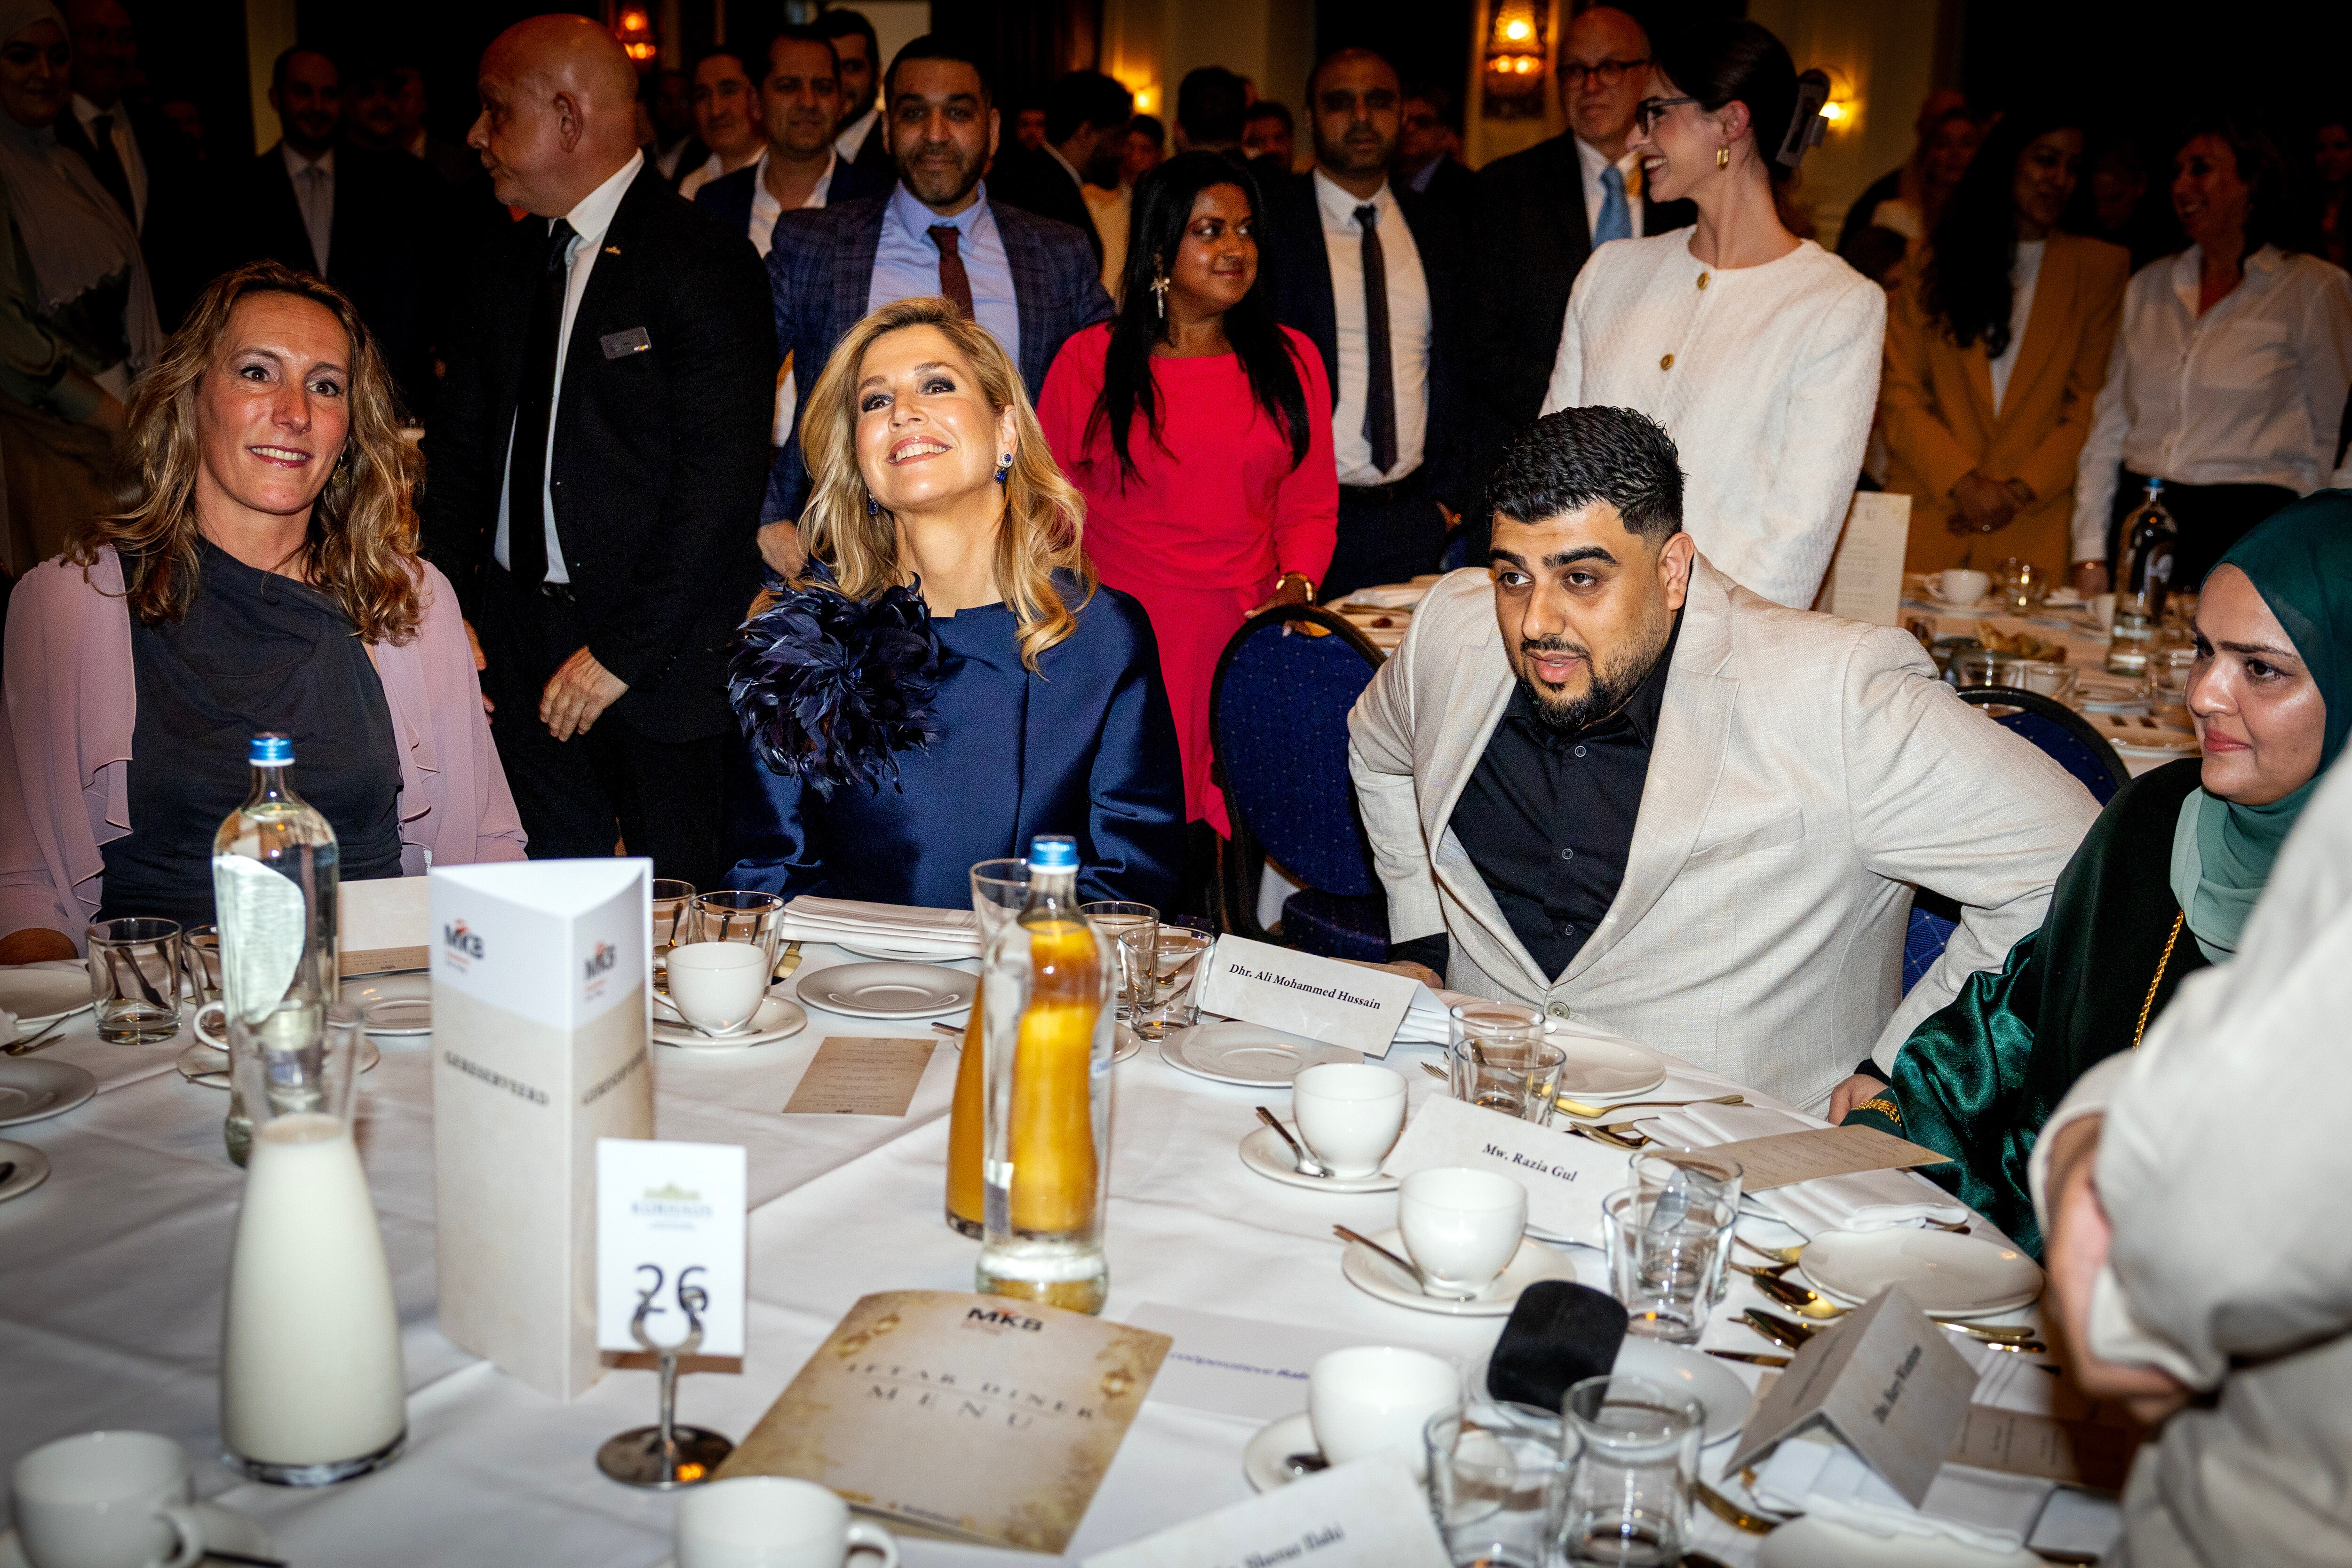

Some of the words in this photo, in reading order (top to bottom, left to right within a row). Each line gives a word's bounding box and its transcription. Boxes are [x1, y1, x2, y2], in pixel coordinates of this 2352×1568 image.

[1229, 963, 1252, 978] Dhr.
[1255, 970, 1273, 982] Ali
[1272, 975, 1337, 998] Mohammed
[1336, 990, 1381, 1010] Hussain
[1482, 1142, 1508, 1161] Mw.
[1512, 1152, 1549, 1173] Razia
[1551, 1165, 1578, 1182] Gul
[635, 1263, 709, 1314] 26
[967, 1307, 1043, 1331] MKB
[866, 1385, 1034, 1430] MENU
